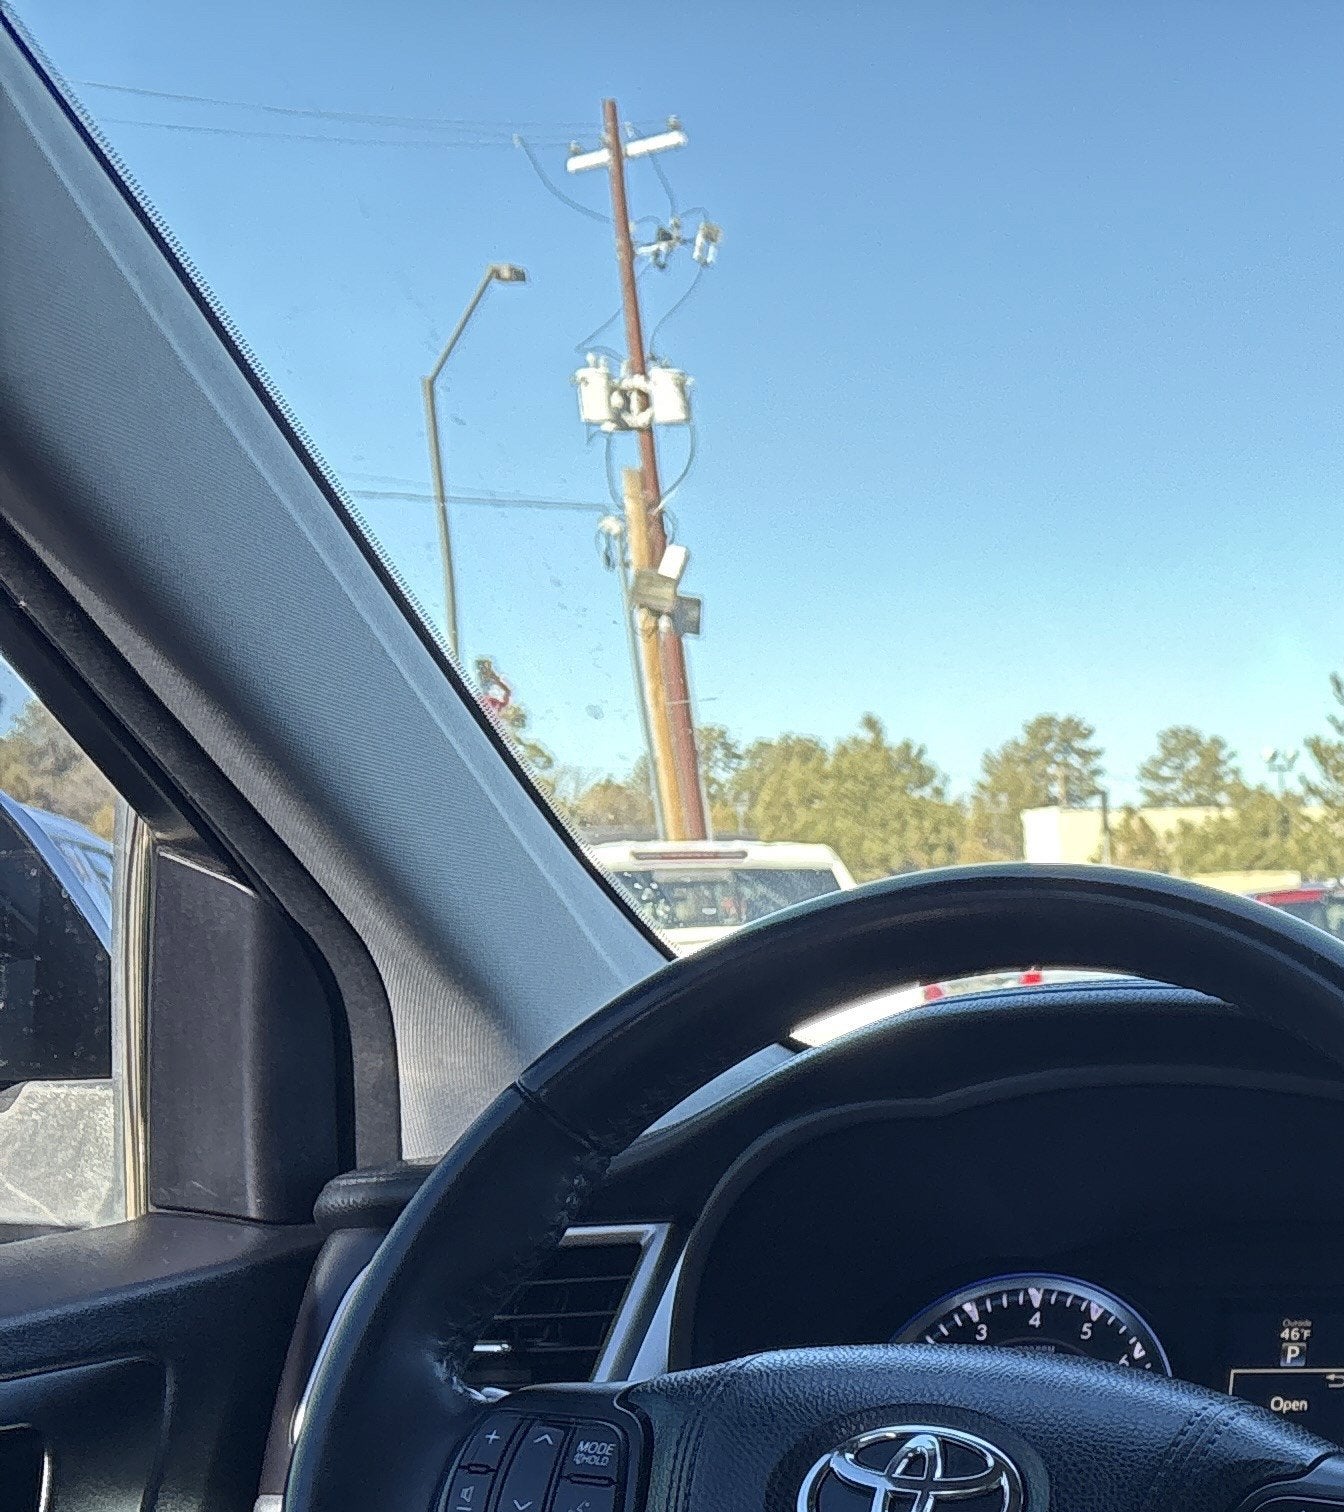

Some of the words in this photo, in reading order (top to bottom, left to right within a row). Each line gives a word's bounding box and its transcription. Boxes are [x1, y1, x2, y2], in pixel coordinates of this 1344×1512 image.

[1028, 1311, 1041, 1328] 4
[975, 1323, 988, 1341] 3
[1080, 1322, 1093, 1340] 5
[1286, 1345, 1300, 1364] P
[1270, 1396, 1308, 1414] Open
[577, 1441, 616, 1455] MODE
